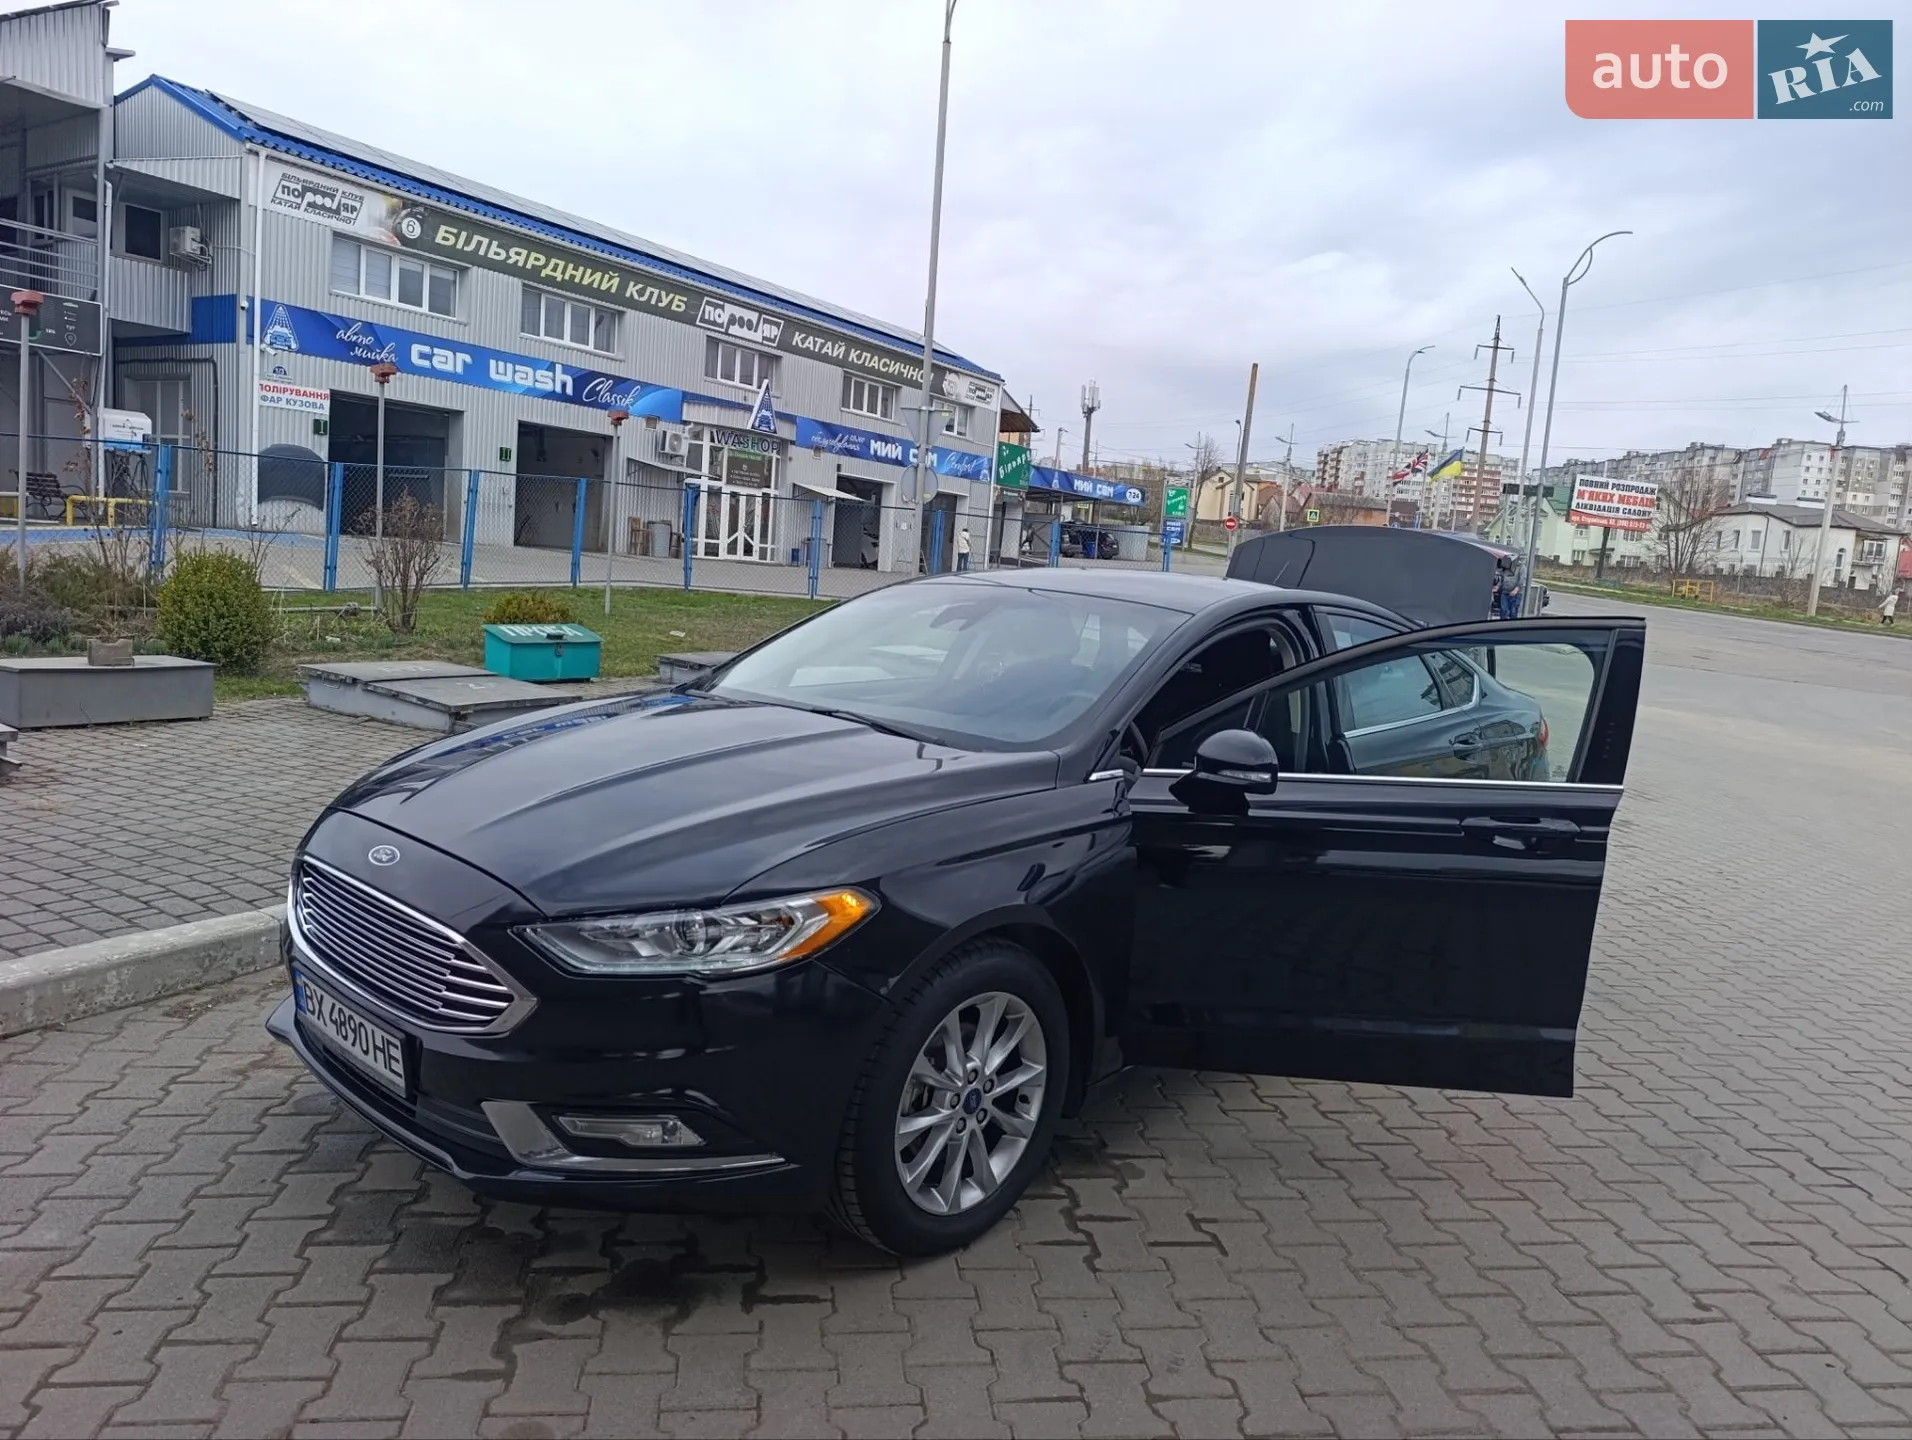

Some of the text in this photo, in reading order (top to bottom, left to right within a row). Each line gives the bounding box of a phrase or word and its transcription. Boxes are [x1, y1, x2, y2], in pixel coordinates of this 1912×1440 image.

[281, 172, 365, 201] БІЛЬЯРДНИЙ КЛУБ
[270, 199, 301, 211] КАТАЙ
[434, 224, 688, 313] БІЛЬЯРДНИЙ КЛУБ
[336, 322, 375, 345] авто
[792, 331, 846, 359] КАТАЙ
[349, 342, 399, 363] мийка
[410, 343, 641, 409] car wash Classik
[260, 394, 325, 410] ФАР КУЗОВА
[715, 429, 780, 453] WASHOP
[870, 439, 902, 460] МИЙ
[1579, 478, 1656, 496] ПОВНИЙ РОЗПРОДАЖ
[1575, 502, 1652, 518] ЛІКВІДАЦІЯ САЛОНУ
[329, 1003, 370, 1056] 4890
